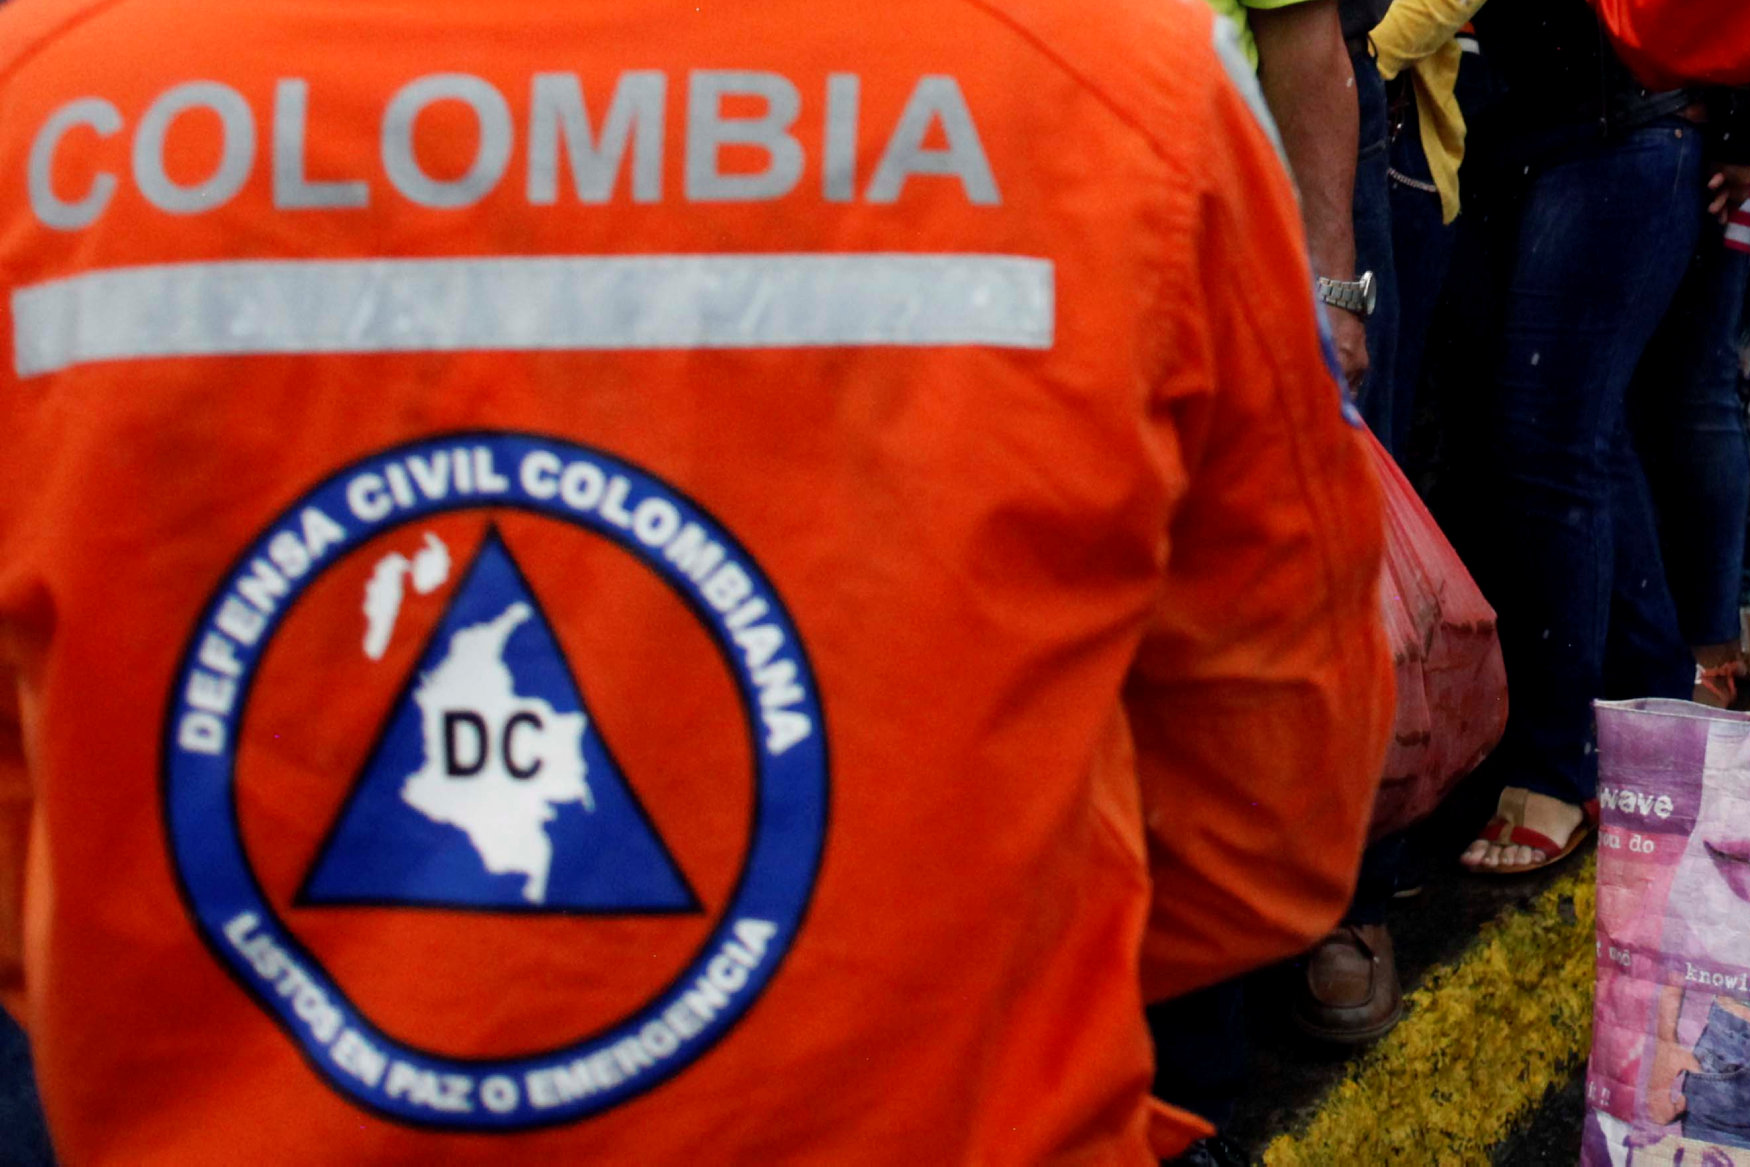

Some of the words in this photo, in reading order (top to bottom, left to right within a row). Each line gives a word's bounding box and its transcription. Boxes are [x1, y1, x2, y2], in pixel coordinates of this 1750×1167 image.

[25, 69, 1002, 230] COLOMBIA
[178, 506, 346, 755] DEFENSA
[346, 446, 509, 522] CIVIL
[520, 440, 812, 755] COLOMBIANA
[443, 710, 544, 780] DC
[1600, 787, 1674, 819] wave
[1629, 834, 1656, 854] do
[330, 1028, 388, 1087] EN
[385, 1061, 474, 1112] PAZ
[480, 1075, 519, 1113] O
